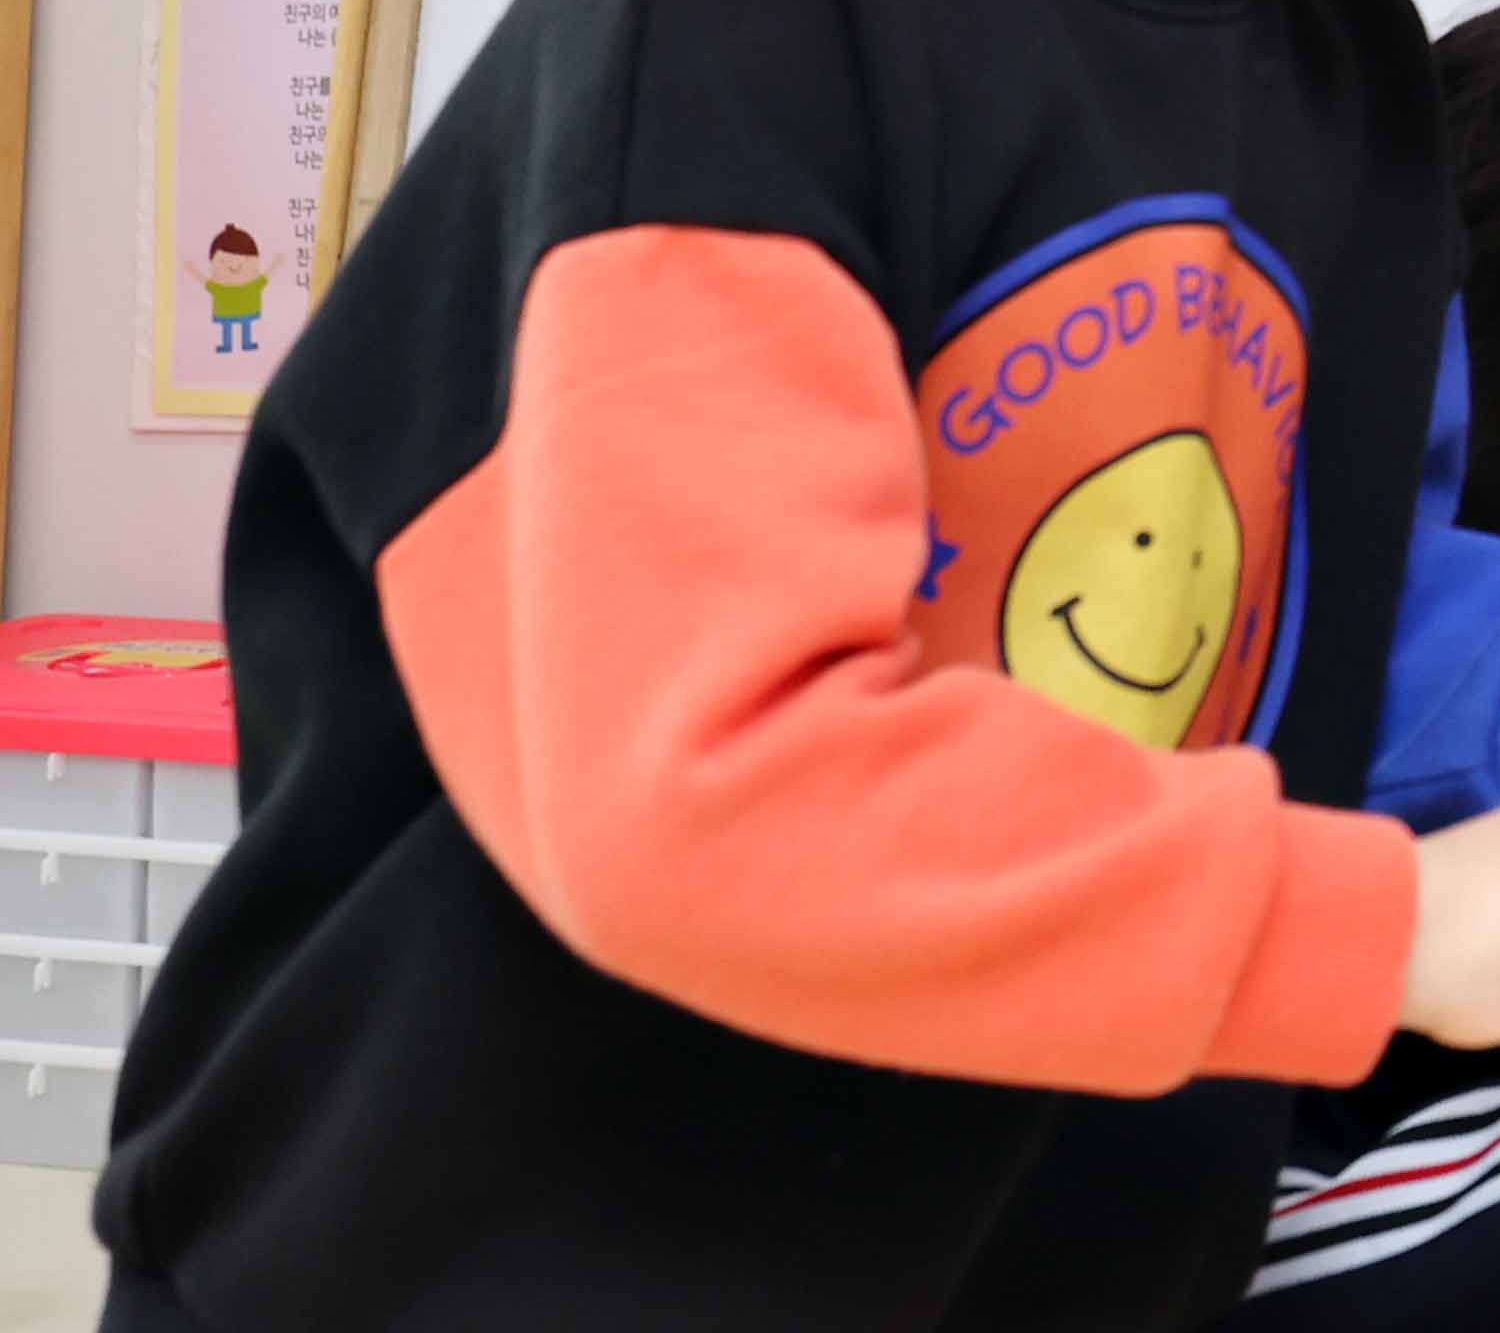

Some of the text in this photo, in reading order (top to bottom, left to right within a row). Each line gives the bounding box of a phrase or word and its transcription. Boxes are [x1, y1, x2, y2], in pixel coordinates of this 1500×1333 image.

[284, 3, 327, 24] 친구의
[297, 27, 327, 48] 나는
[295, 100, 325, 121] 나는
[295, 150, 324, 171] 나는
[288, 198, 318, 219] 친구
[295, 223, 315, 244] 나
[296, 247, 311, 268] 친
[295, 273, 311, 291] 나
[938, 279, 1157, 456] GOOD
